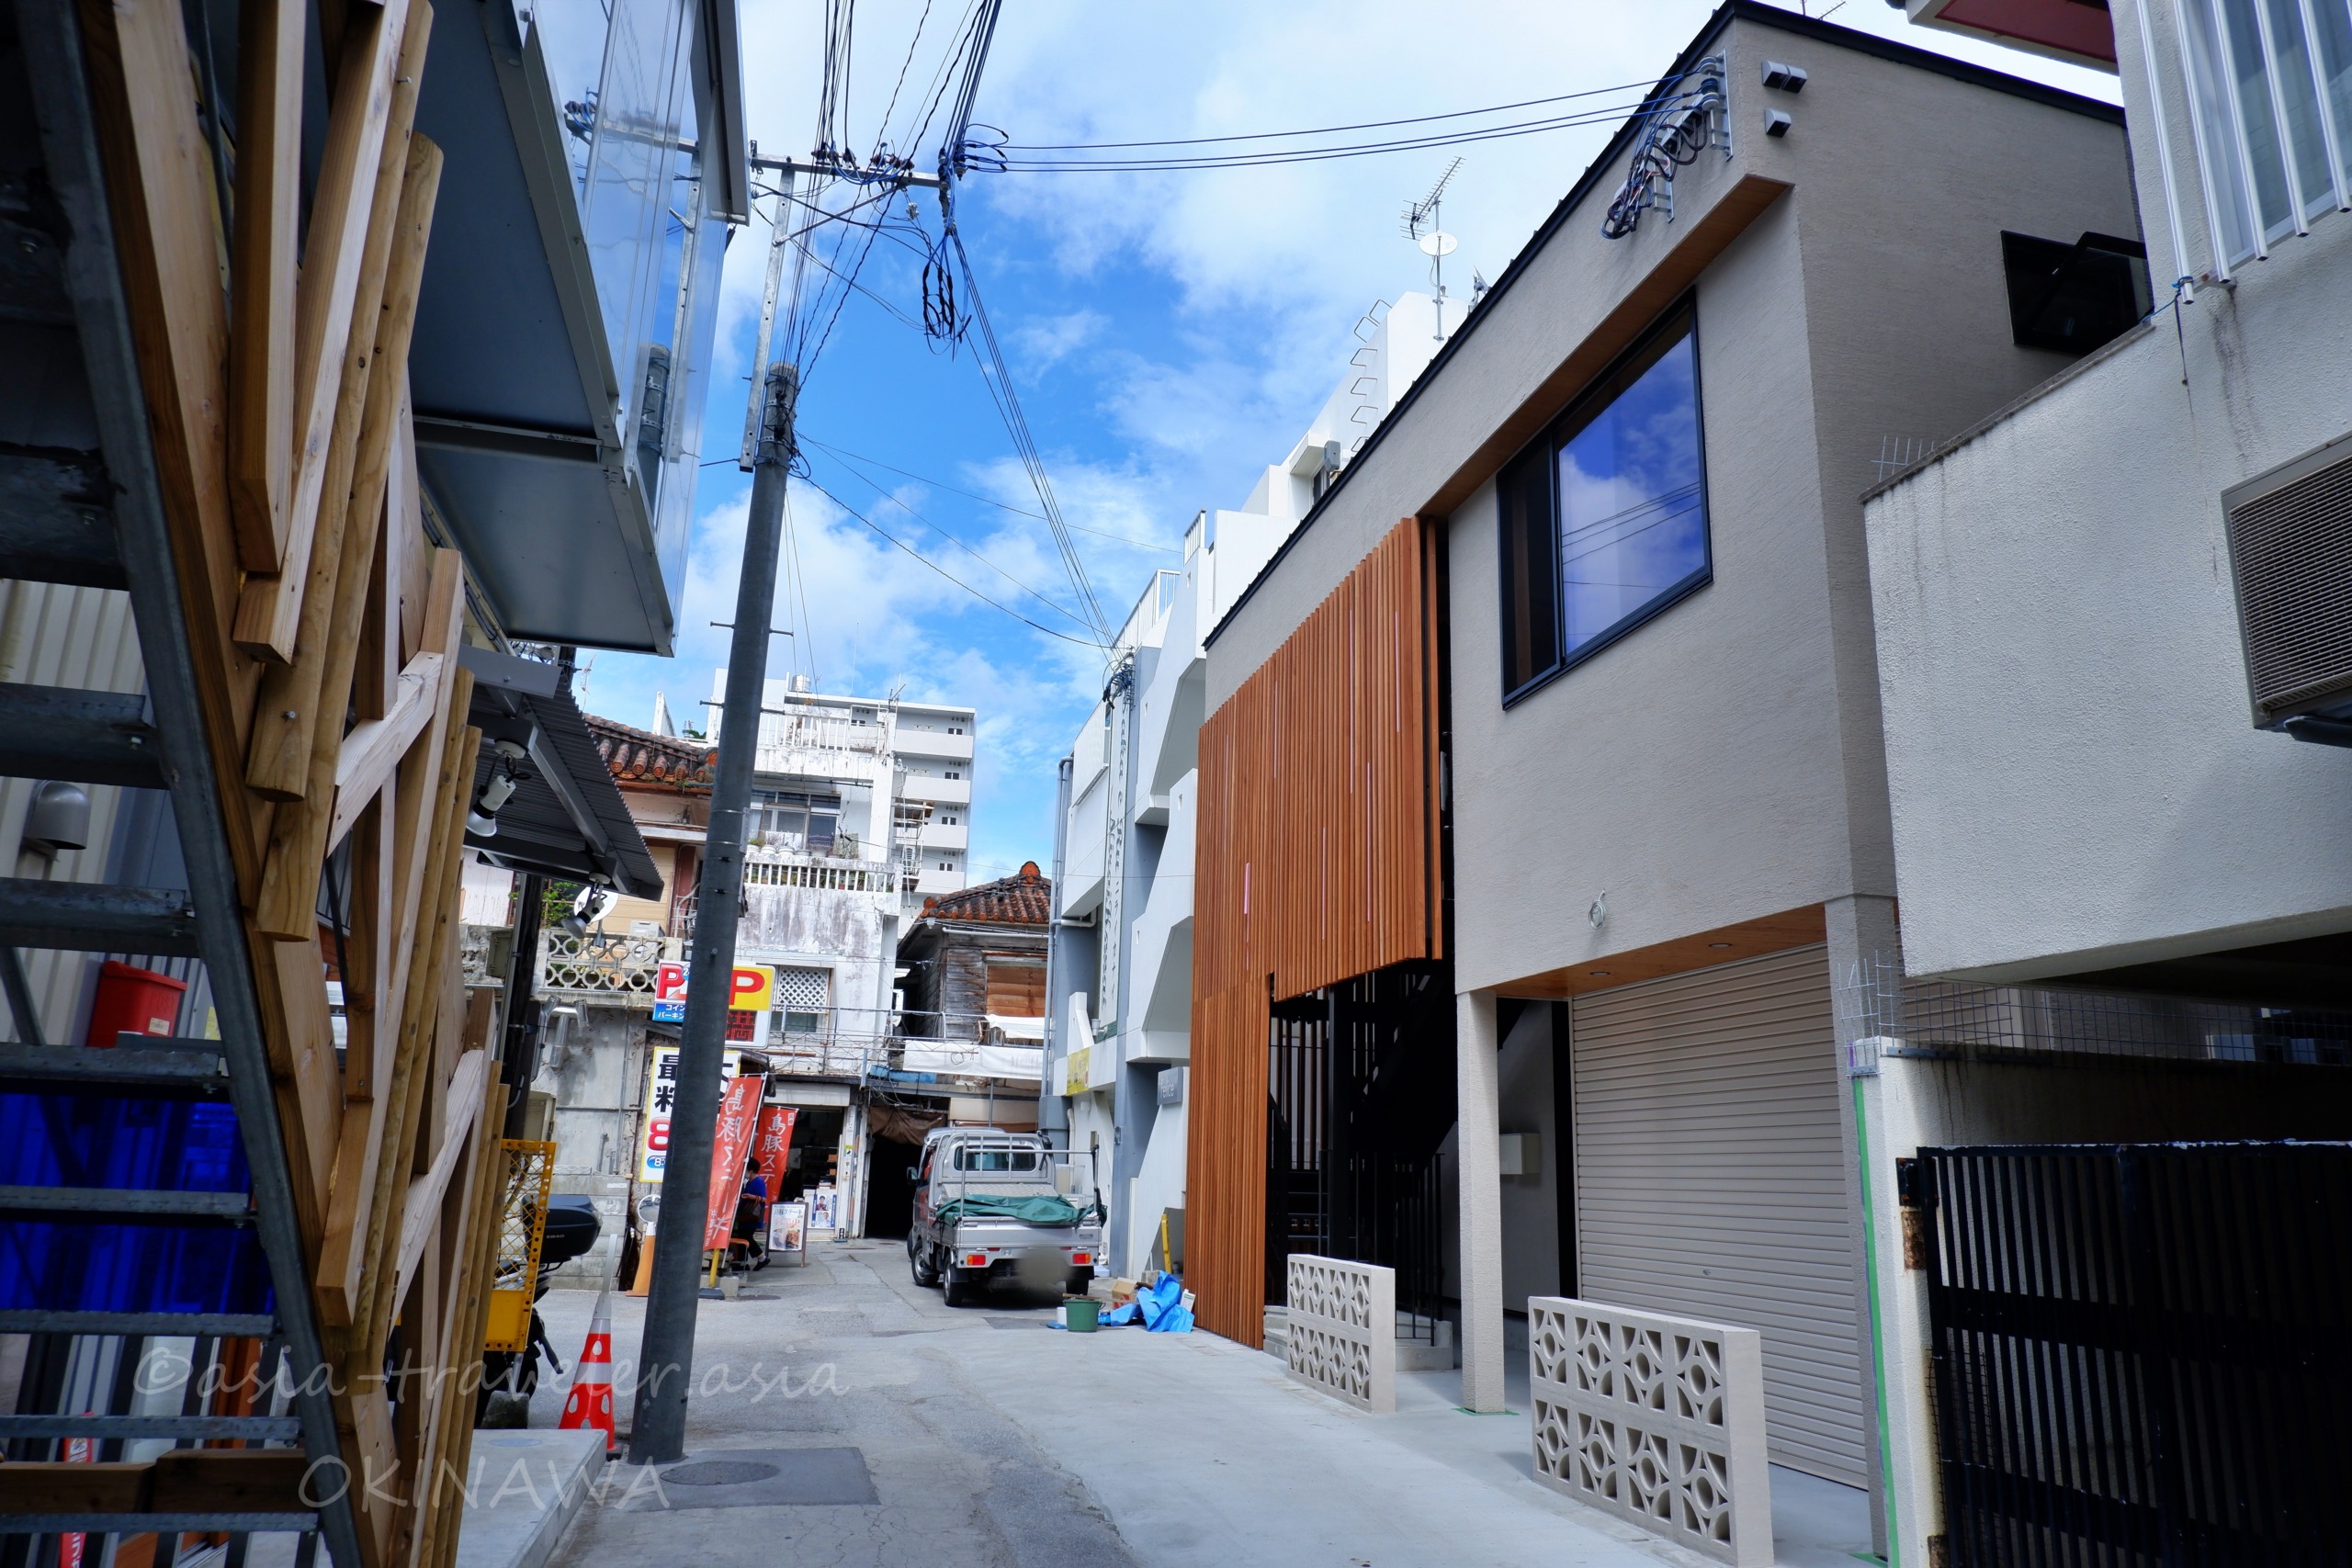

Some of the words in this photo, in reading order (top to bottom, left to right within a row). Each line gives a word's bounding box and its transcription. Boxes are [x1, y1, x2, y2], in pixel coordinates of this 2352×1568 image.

[656, 963, 686, 999] P
[729, 969, 765, 1006] P
[657, 1011, 684, 1020] パーキン
[761, 1113, 786, 1185] 島豚ステ
